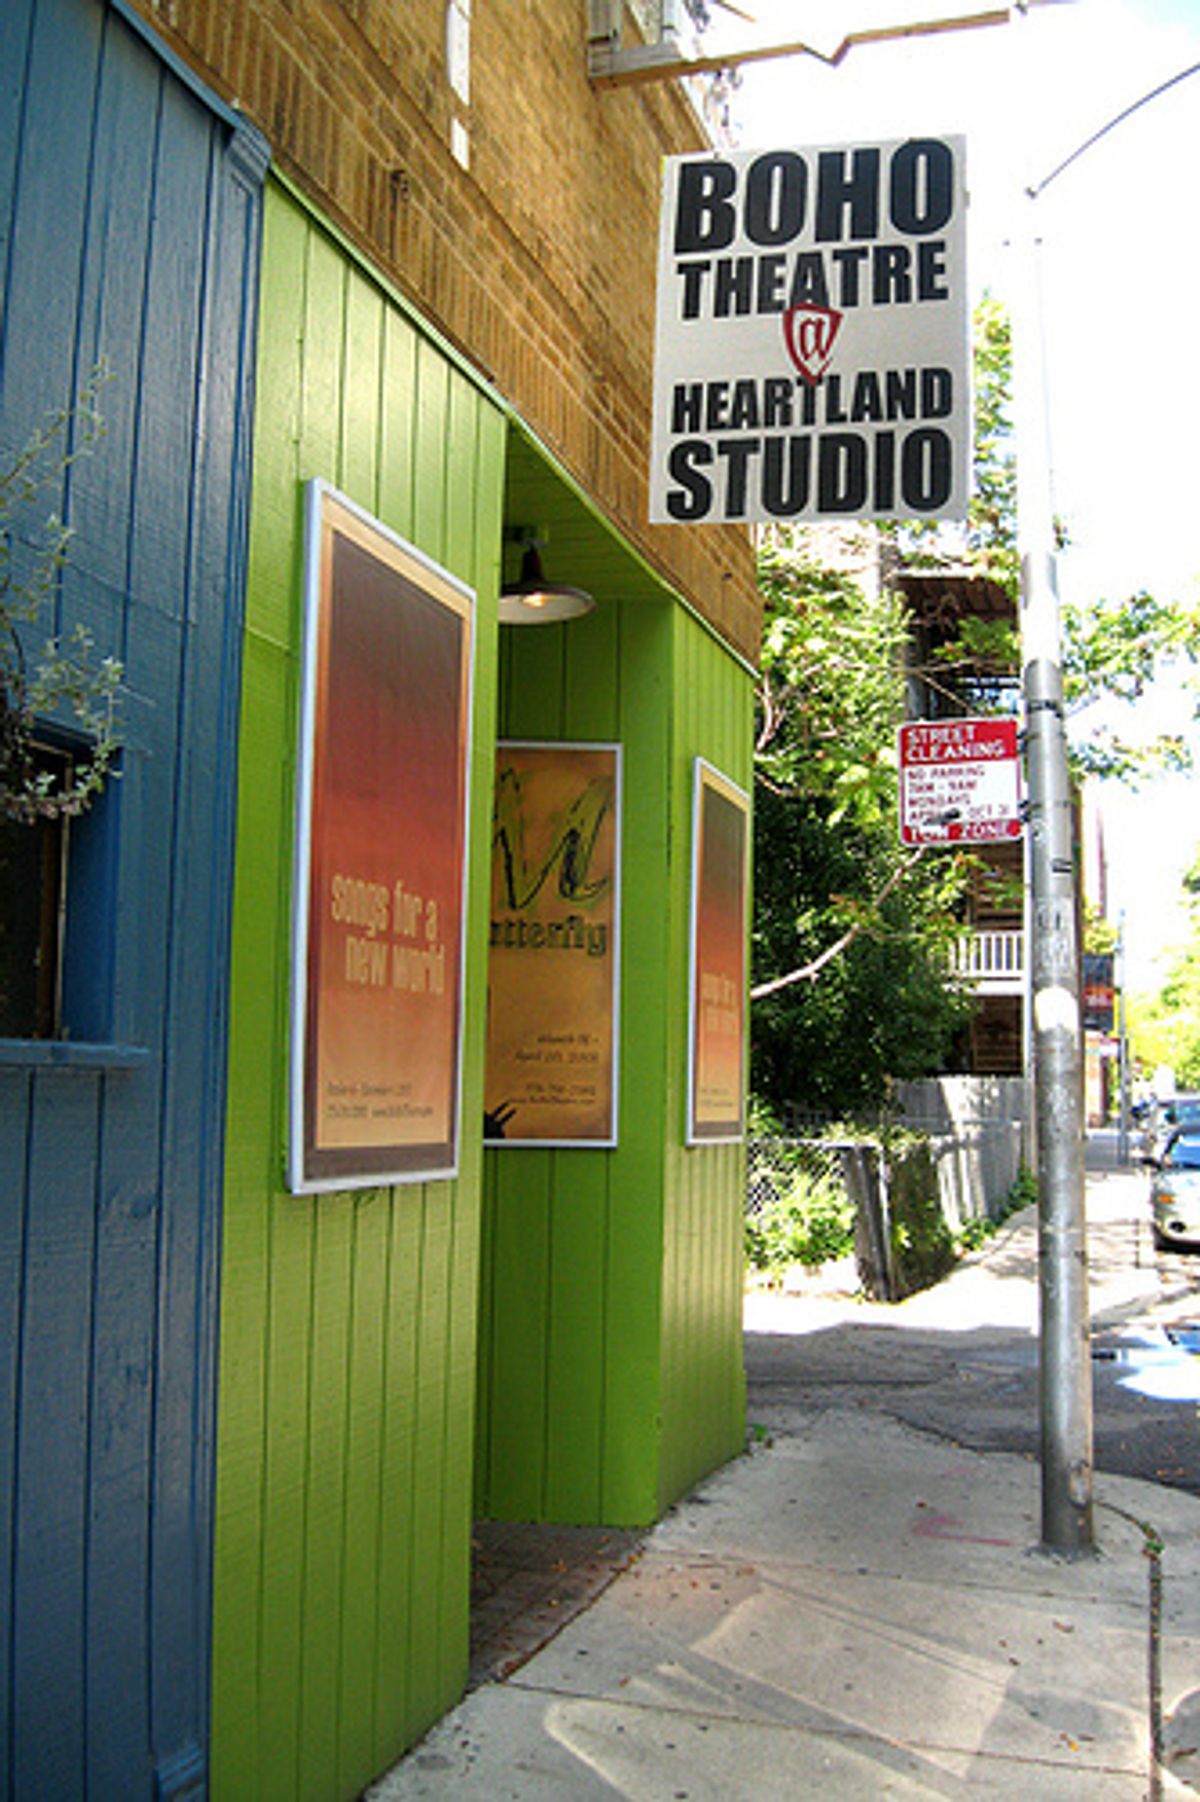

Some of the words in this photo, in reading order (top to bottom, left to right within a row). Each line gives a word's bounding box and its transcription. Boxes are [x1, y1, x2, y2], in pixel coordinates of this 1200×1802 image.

[674, 138, 954, 254] BOHO
[676, 241, 949, 321] THEATRE
[671, 367, 953, 434] HEARTLAND
[665, 427, 953, 521] STUDIO
[907, 739, 1006, 761] CLEANING
[908, 725, 975, 743] STREET
[331, 874, 390, 937] songs
[394, 880, 422, 938] for
[425, 900, 437, 941] a
[346, 935, 387, 986] new
[393, 943, 445, 995] world
